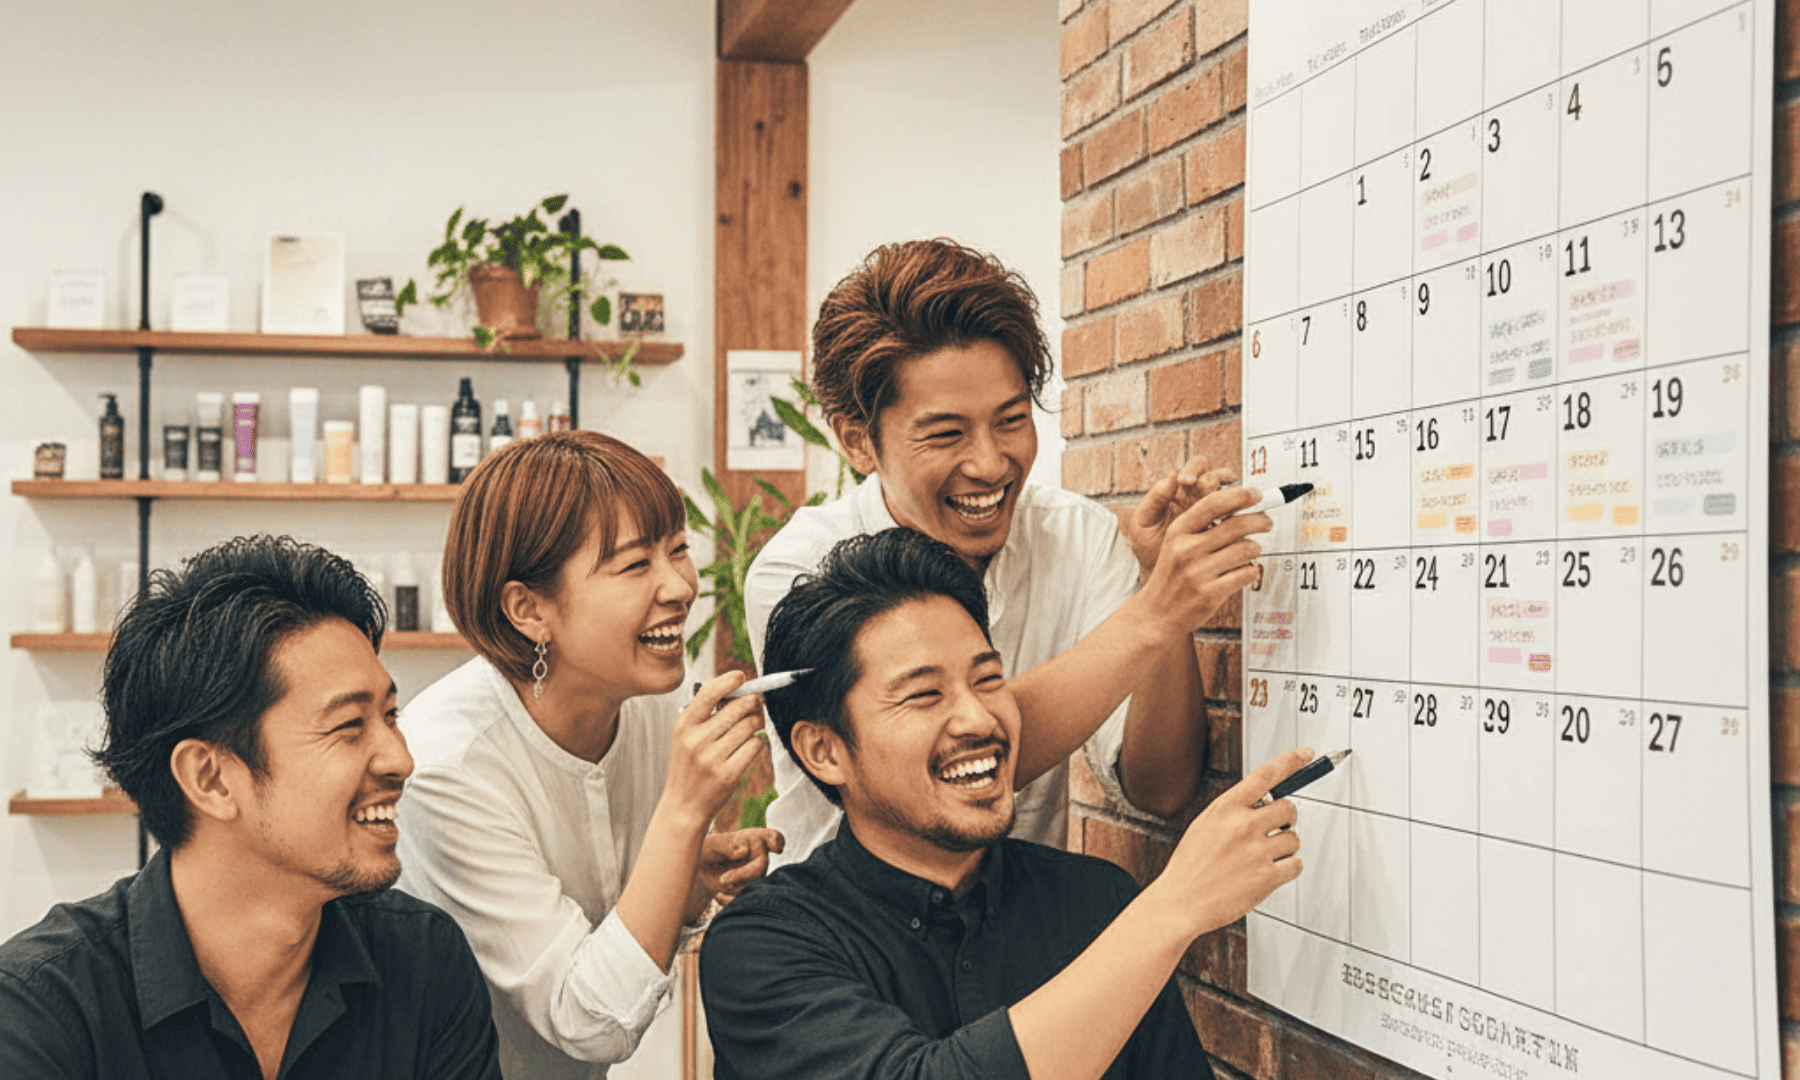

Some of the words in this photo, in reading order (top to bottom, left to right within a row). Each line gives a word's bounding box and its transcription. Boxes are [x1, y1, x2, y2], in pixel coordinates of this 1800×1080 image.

[1656, 46, 1673, 88] 5
[1567, 82, 1582, 121] 4
[1487, 117, 1501, 154] 3
[1419, 147, 1432, 182] 2
[1356, 174, 1367, 206] 1
[1653, 208, 1686, 253] 13
[1564, 235, 1592, 278] 11
[1486, 258, 1512, 298] 10
[1356, 300, 1367, 332] 8
[1417, 282, 1430, 316] 9
[1252, 329, 1261, 358] 6
[1302, 316, 1311, 346] 7
[1563, 391, 1591, 431] 18
[1651, 376, 1684, 419] 19
[1416, 417, 1440, 452] 16
[1485, 405, 1511, 443] 17
[1300, 438, 1319, 469] 11
[1354, 428, 1376, 461] 15
[1299, 561, 1319, 591] 11
[1353, 558, 1376, 590] 22
[1414, 555, 1439, 592] 24
[1484, 553, 1510, 589] 21
[1561, 550, 1592, 589] 25
[1650, 547, 1684, 588] 26
[1298, 682, 1319, 715] 25
[1352, 686, 1375, 719] 27
[1413, 692, 1438, 728] 28
[1560, 704, 1591, 744] 20
[1648, 711, 1683, 753] 27
